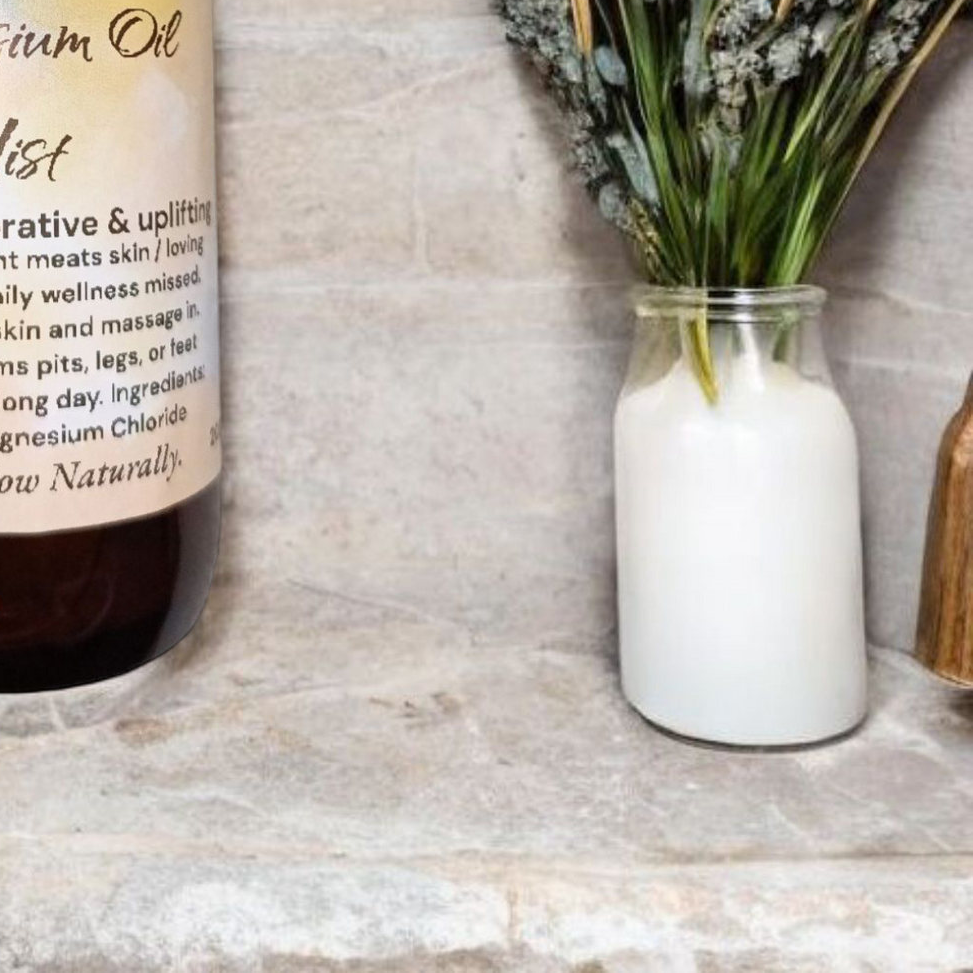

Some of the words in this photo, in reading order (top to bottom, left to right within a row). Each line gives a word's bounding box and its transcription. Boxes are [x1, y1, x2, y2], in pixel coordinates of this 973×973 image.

[108, 8, 183, 58] Oil
[107, 206, 131, 235] &
[138, 197, 212, 237] uplifting
[27, 248, 102, 270] meats
[109, 242, 150, 264] skin
[166, 234, 204, 257] loving
[41, 281, 140, 304] wellness
[49, 315, 93, 338] and
[101, 308, 183, 335] massage
[37, 353, 89, 380] pits,
[96, 350, 143, 373] legs,
[148, 345, 166, 362] or
[170, 333, 198, 357] feet
[56, 388, 104, 412] day.
[110, 403, 188, 438] Chloride
[49, 443, 183, 492] Naturally.
